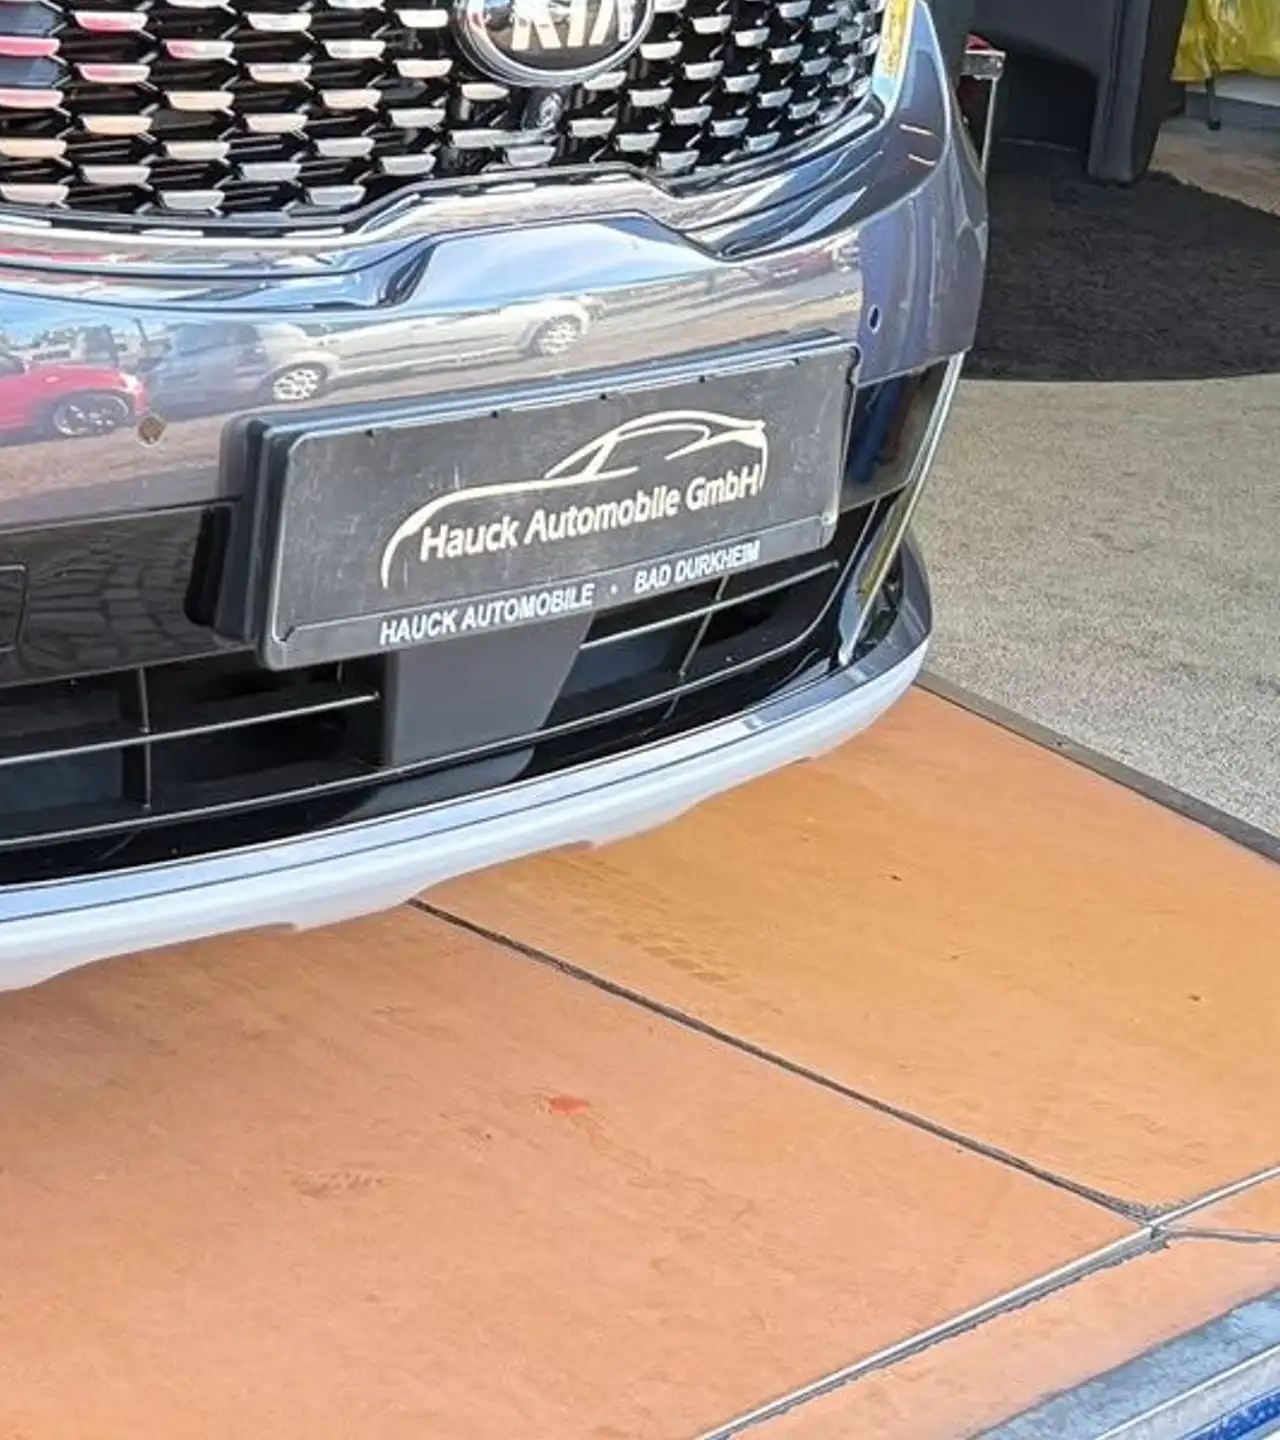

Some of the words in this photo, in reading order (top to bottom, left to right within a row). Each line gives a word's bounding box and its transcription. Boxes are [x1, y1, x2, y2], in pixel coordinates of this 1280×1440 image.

[419, 515, 521, 563] Hauck
[523, 485, 682, 545] Automobile
[685, 463, 762, 511] GmbH
[378, 607, 460, 646] HAUCK
[460, 582, 597, 631] AUTOMOBILE
[633, 563, 672, 595] BAD
